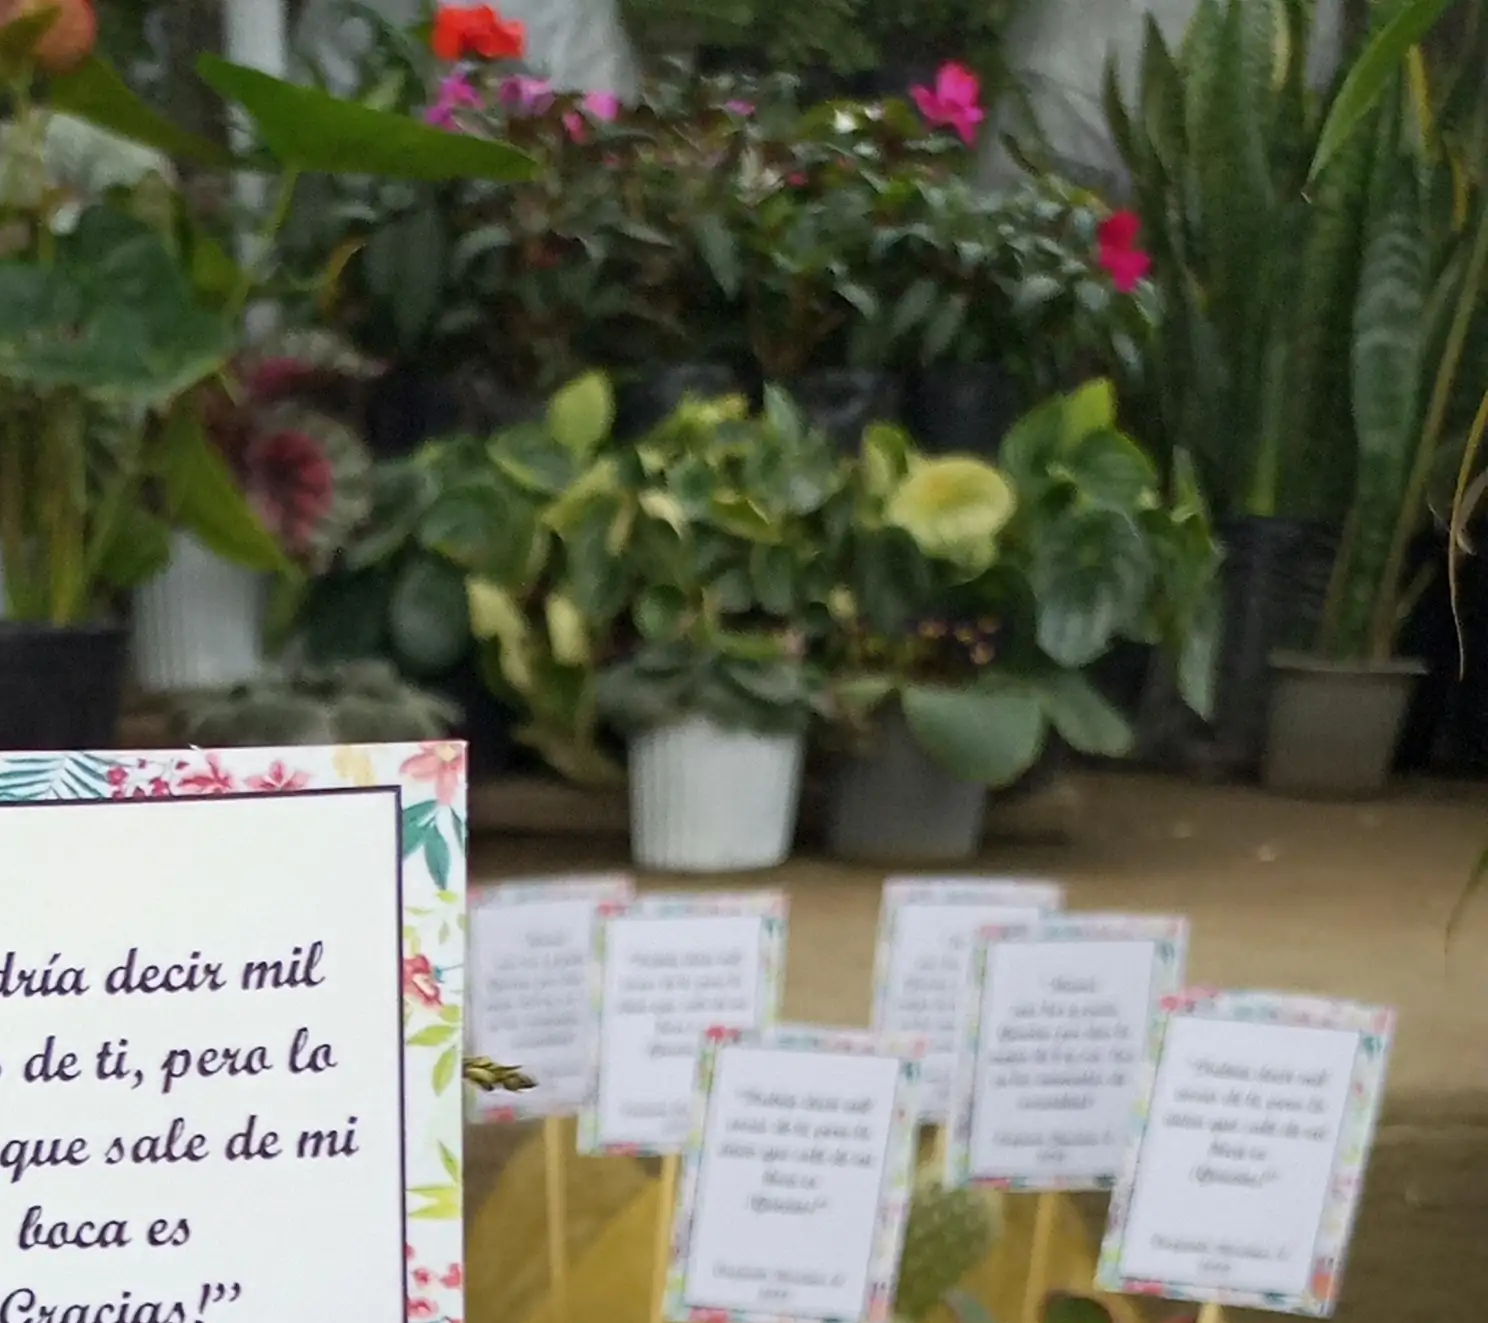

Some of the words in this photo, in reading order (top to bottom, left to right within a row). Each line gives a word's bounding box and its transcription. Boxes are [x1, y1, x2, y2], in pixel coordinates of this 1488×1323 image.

[106, 948, 226, 994] decir
[242, 941, 326, 990] mil
[24, 1036, 81, 1082] de
[96, 1039, 144, 1088] ti,
[161, 1046, 273, 1094] pero
[288, 1028, 337, 1074] lo
[0, 1138, 90, 1183] que
[106, 1118, 208, 1164] sale
[225, 1115, 282, 1160] de
[296, 1116, 360, 1158] mi
[18, 1206, 131, 1250] boca
[147, 1218, 190, 1246] es
